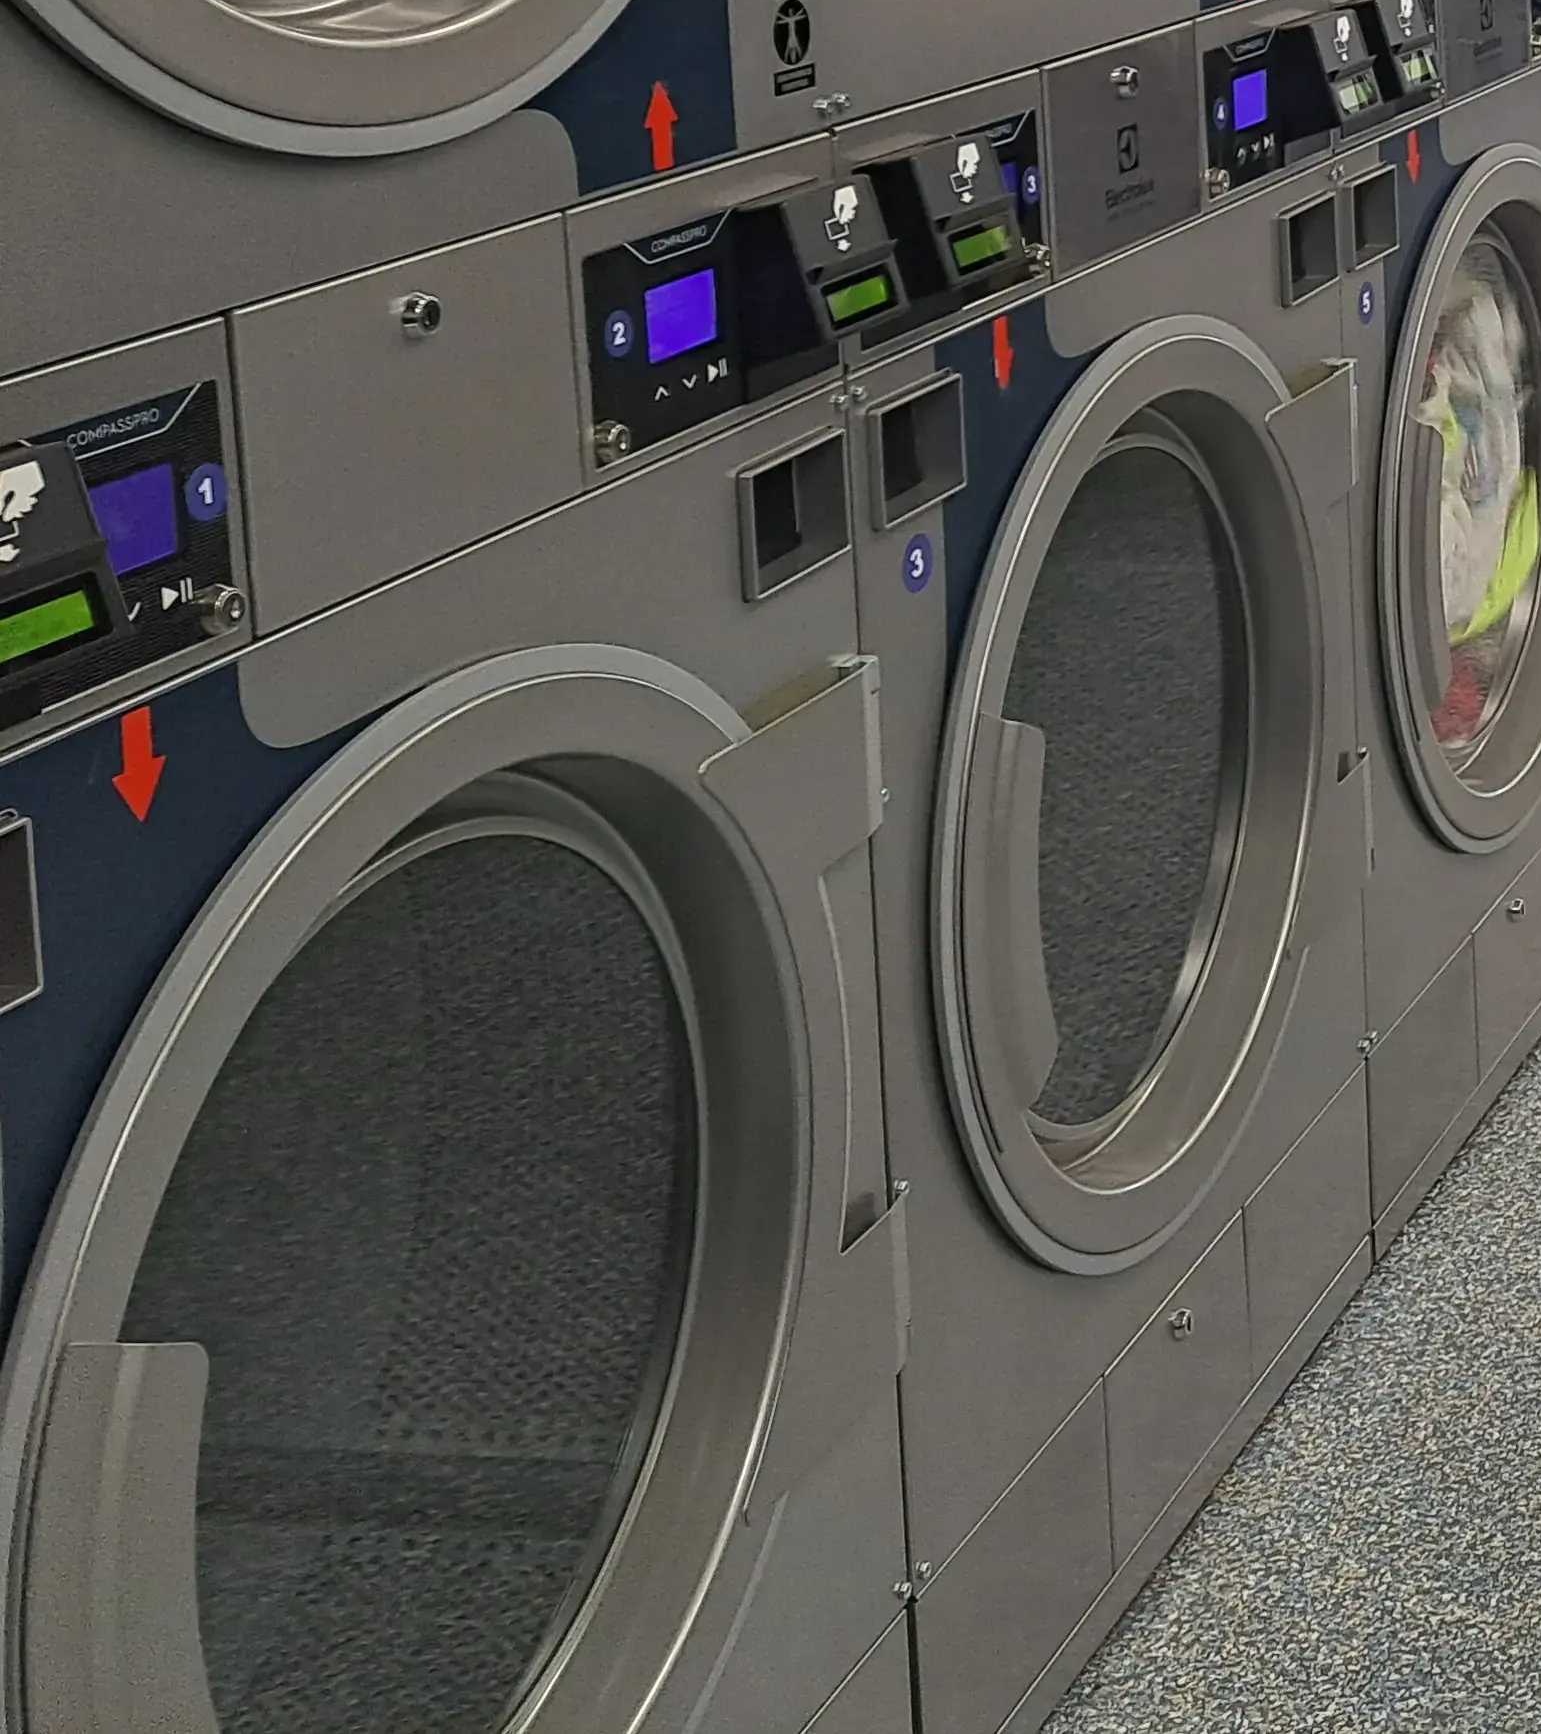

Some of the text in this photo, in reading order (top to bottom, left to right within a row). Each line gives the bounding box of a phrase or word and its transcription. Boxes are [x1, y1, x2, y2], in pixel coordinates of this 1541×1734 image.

[1027, 175, 1037, 194] 3
[651, 223, 708, 254] COMPASSPRO
[1362, 290, 1371, 314] 5
[611, 321, 627, 347] 2
[66, 408, 160, 449] COMPASSPRO
[197, 476, 215, 506] 1
[909, 548, 925, 579] 3
